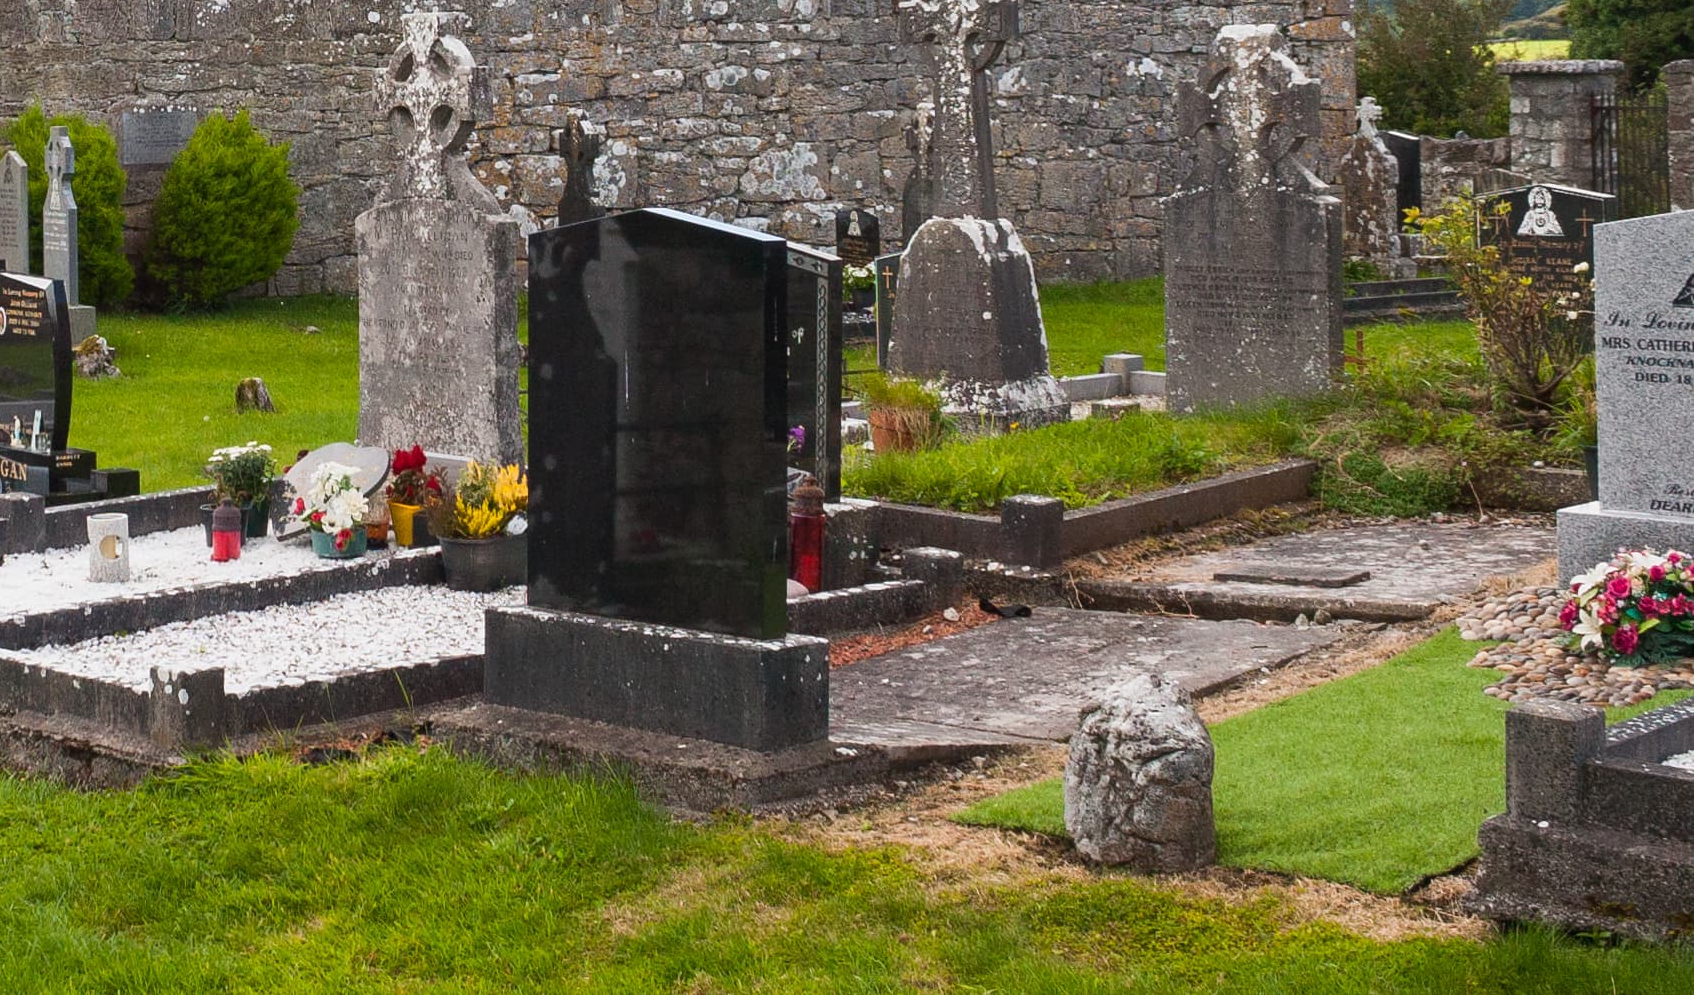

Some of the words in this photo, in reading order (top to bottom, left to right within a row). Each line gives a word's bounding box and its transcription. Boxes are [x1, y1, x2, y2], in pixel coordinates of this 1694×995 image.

[1603, 311, 1630, 327] In
[1601, 336, 1631, 349] MRS
[1634, 372, 1668, 383] DIED
[1677, 374, 1692, 385] 18
[1650, 499, 1694, 513] DEAR
